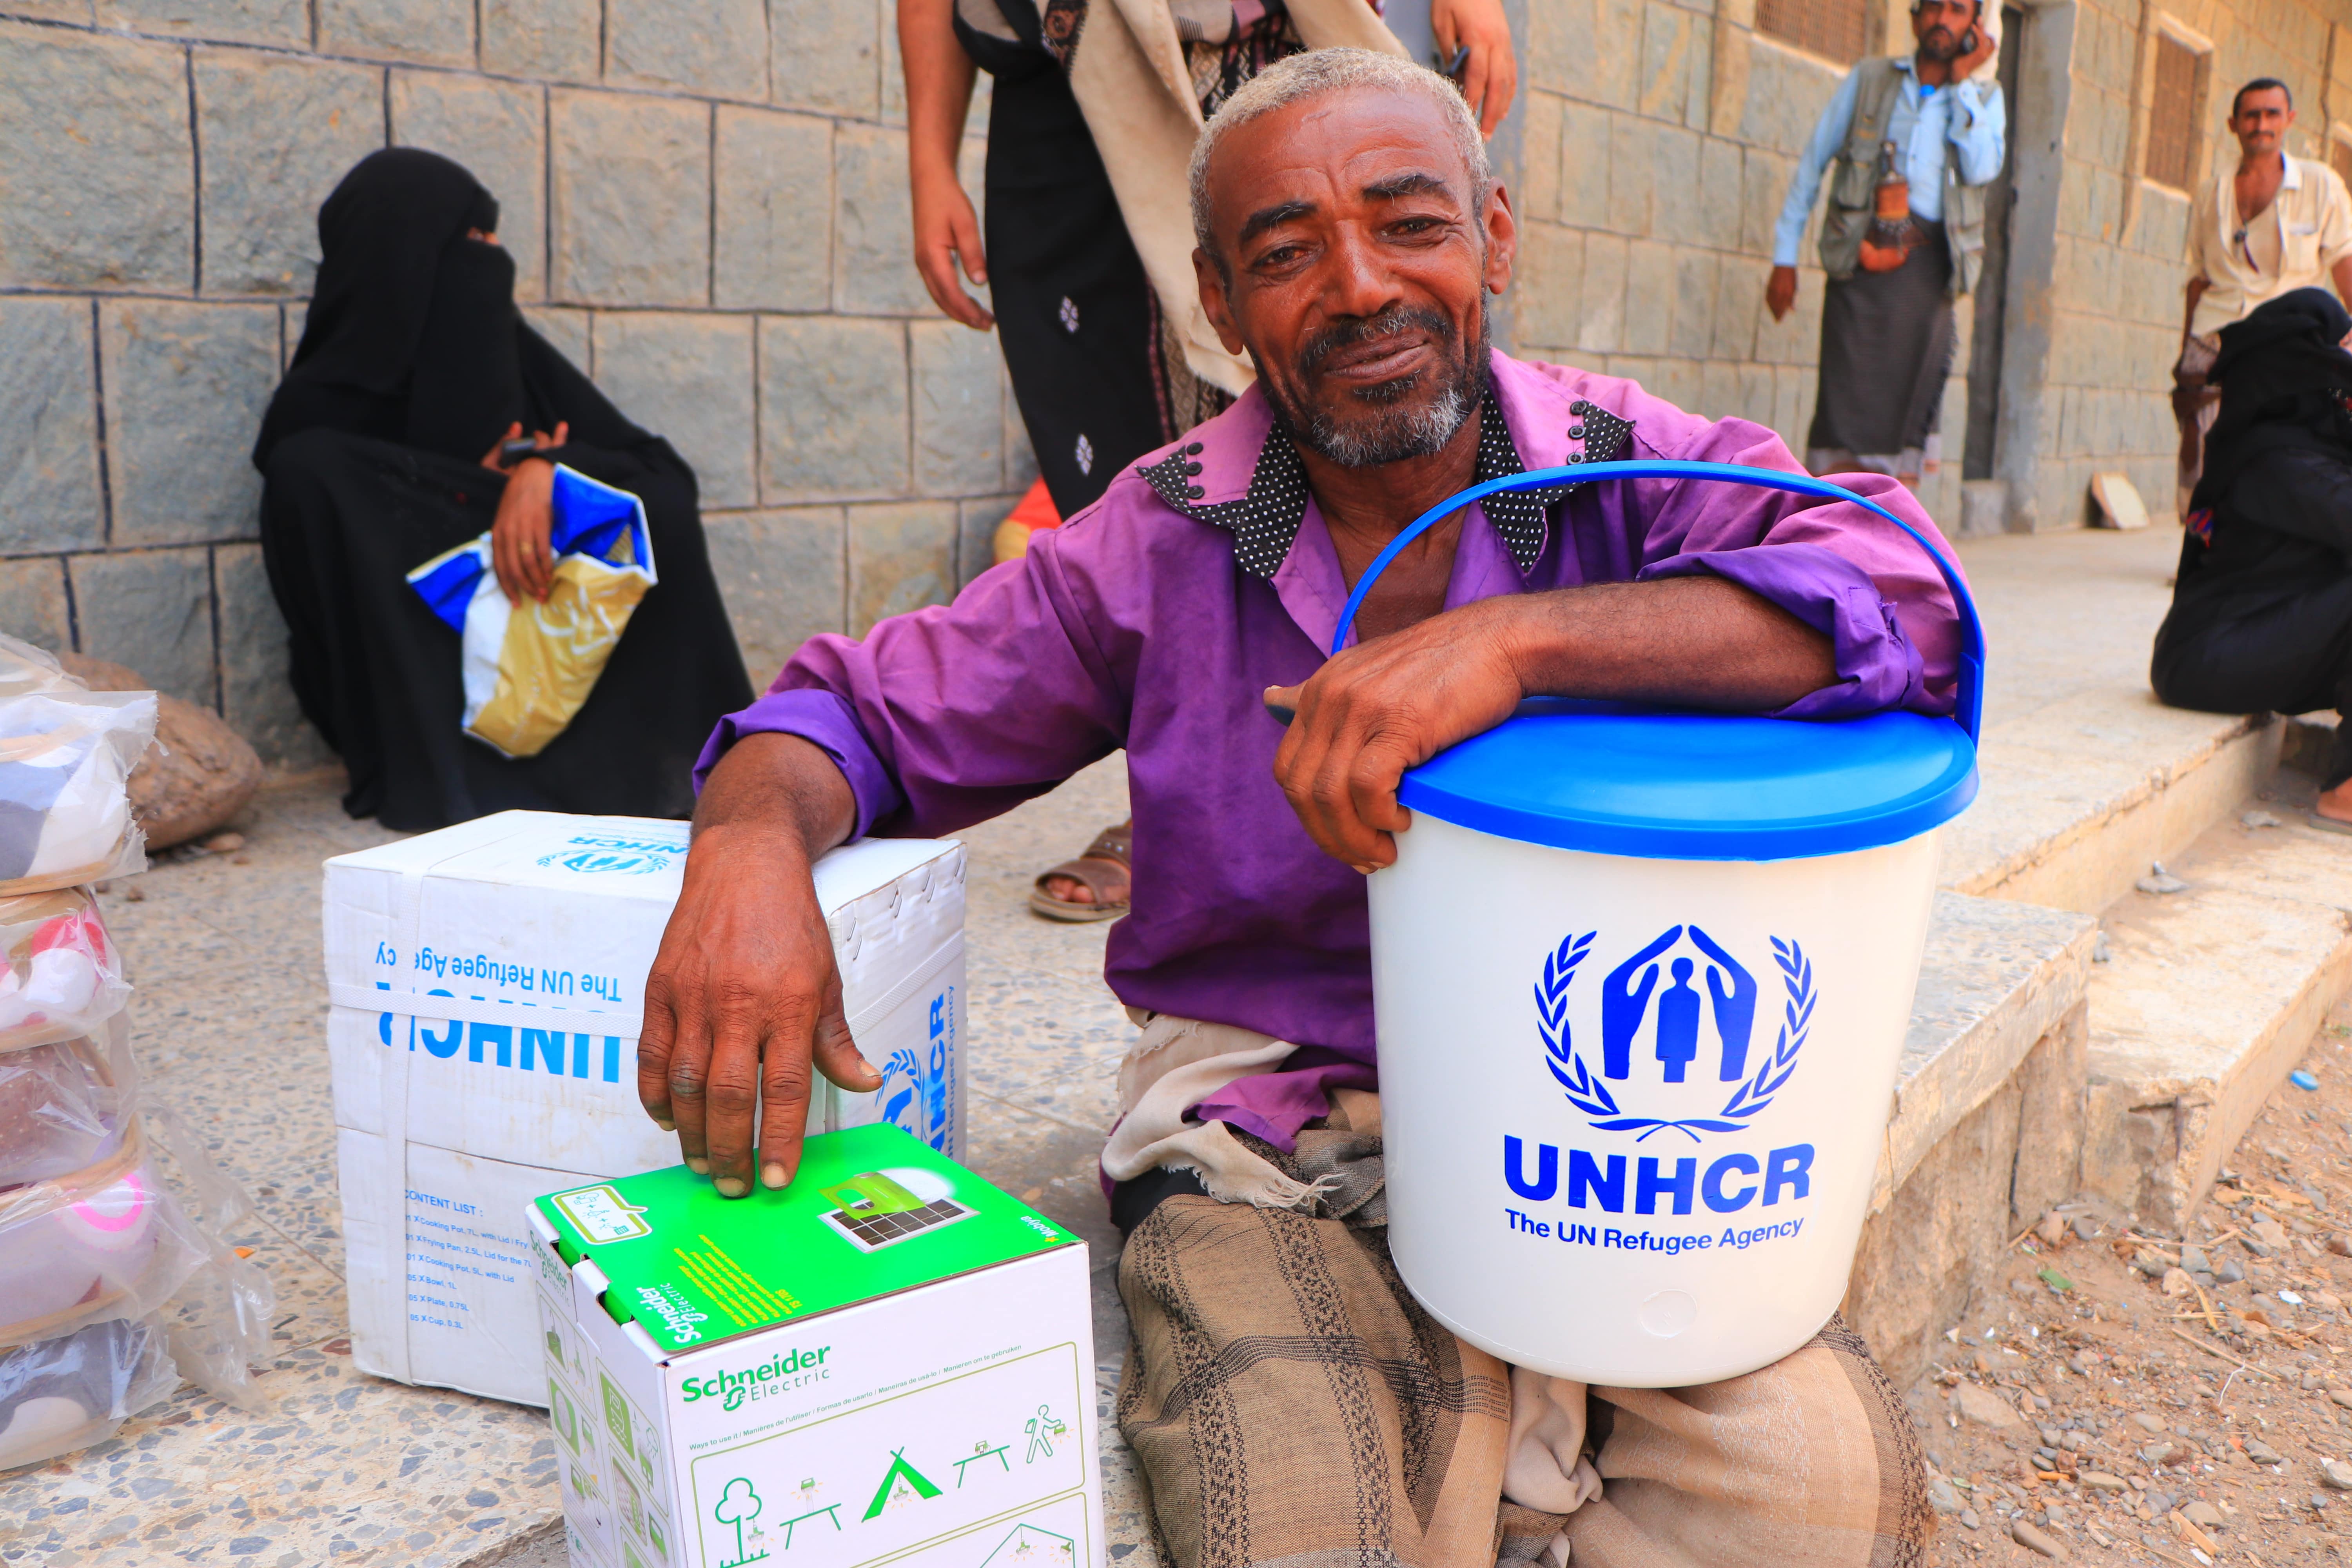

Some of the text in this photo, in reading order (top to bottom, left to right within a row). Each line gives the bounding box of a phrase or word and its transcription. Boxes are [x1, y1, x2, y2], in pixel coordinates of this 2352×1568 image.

[568, 837, 689, 855] NHCR
[376, 942, 622, 1002] The UN Refugee Agecy
[1504, 1135, 1815, 1214] UNHCR
[453, 1201, 477, 1215] LIST
[420, 1217, 450, 1232] Cooking
[1020, 1216, 1059, 1237] Mobiya
[1505, 1209, 1805, 1255] The UN Refugee Agency
[423, 1236, 446, 1249] Frying
[484, 1251, 496, 1259] Lid
[510, 1256, 523, 1265] the
[530, 1230, 567, 1291] Schneider
[407, 1273, 417, 1282] 05
[448, 1281, 457, 1290] 1L
[425, 1256, 454, 1271] Cooking
[503, 1274, 515, 1283] Lid
[408, 1294, 418, 1302] 05
[449, 1301, 470, 1311] 0.75L
[660, 1283, 696, 1313] Electric
[410, 1313, 419, 1322] 05
[448, 1319, 463, 1329] 0.3L
[636, 1287, 702, 1343] Schneider
[681, 1346, 831, 1402] Schneider
[751, 1368, 830, 1401] Electric
[690, 1442, 709, 1450] Ways
[743, 1423, 774, 1436] Manières
[786, 1411, 811, 1423] l'utiliser
[817, 1402, 841, 1413] Formas
[853, 1392, 873, 1401] usarlo
[878, 1381, 907, 1394] Maneiras
[944, 1361, 972, 1373] Manieren
[991, 1345, 1021, 1359] gebruiken
